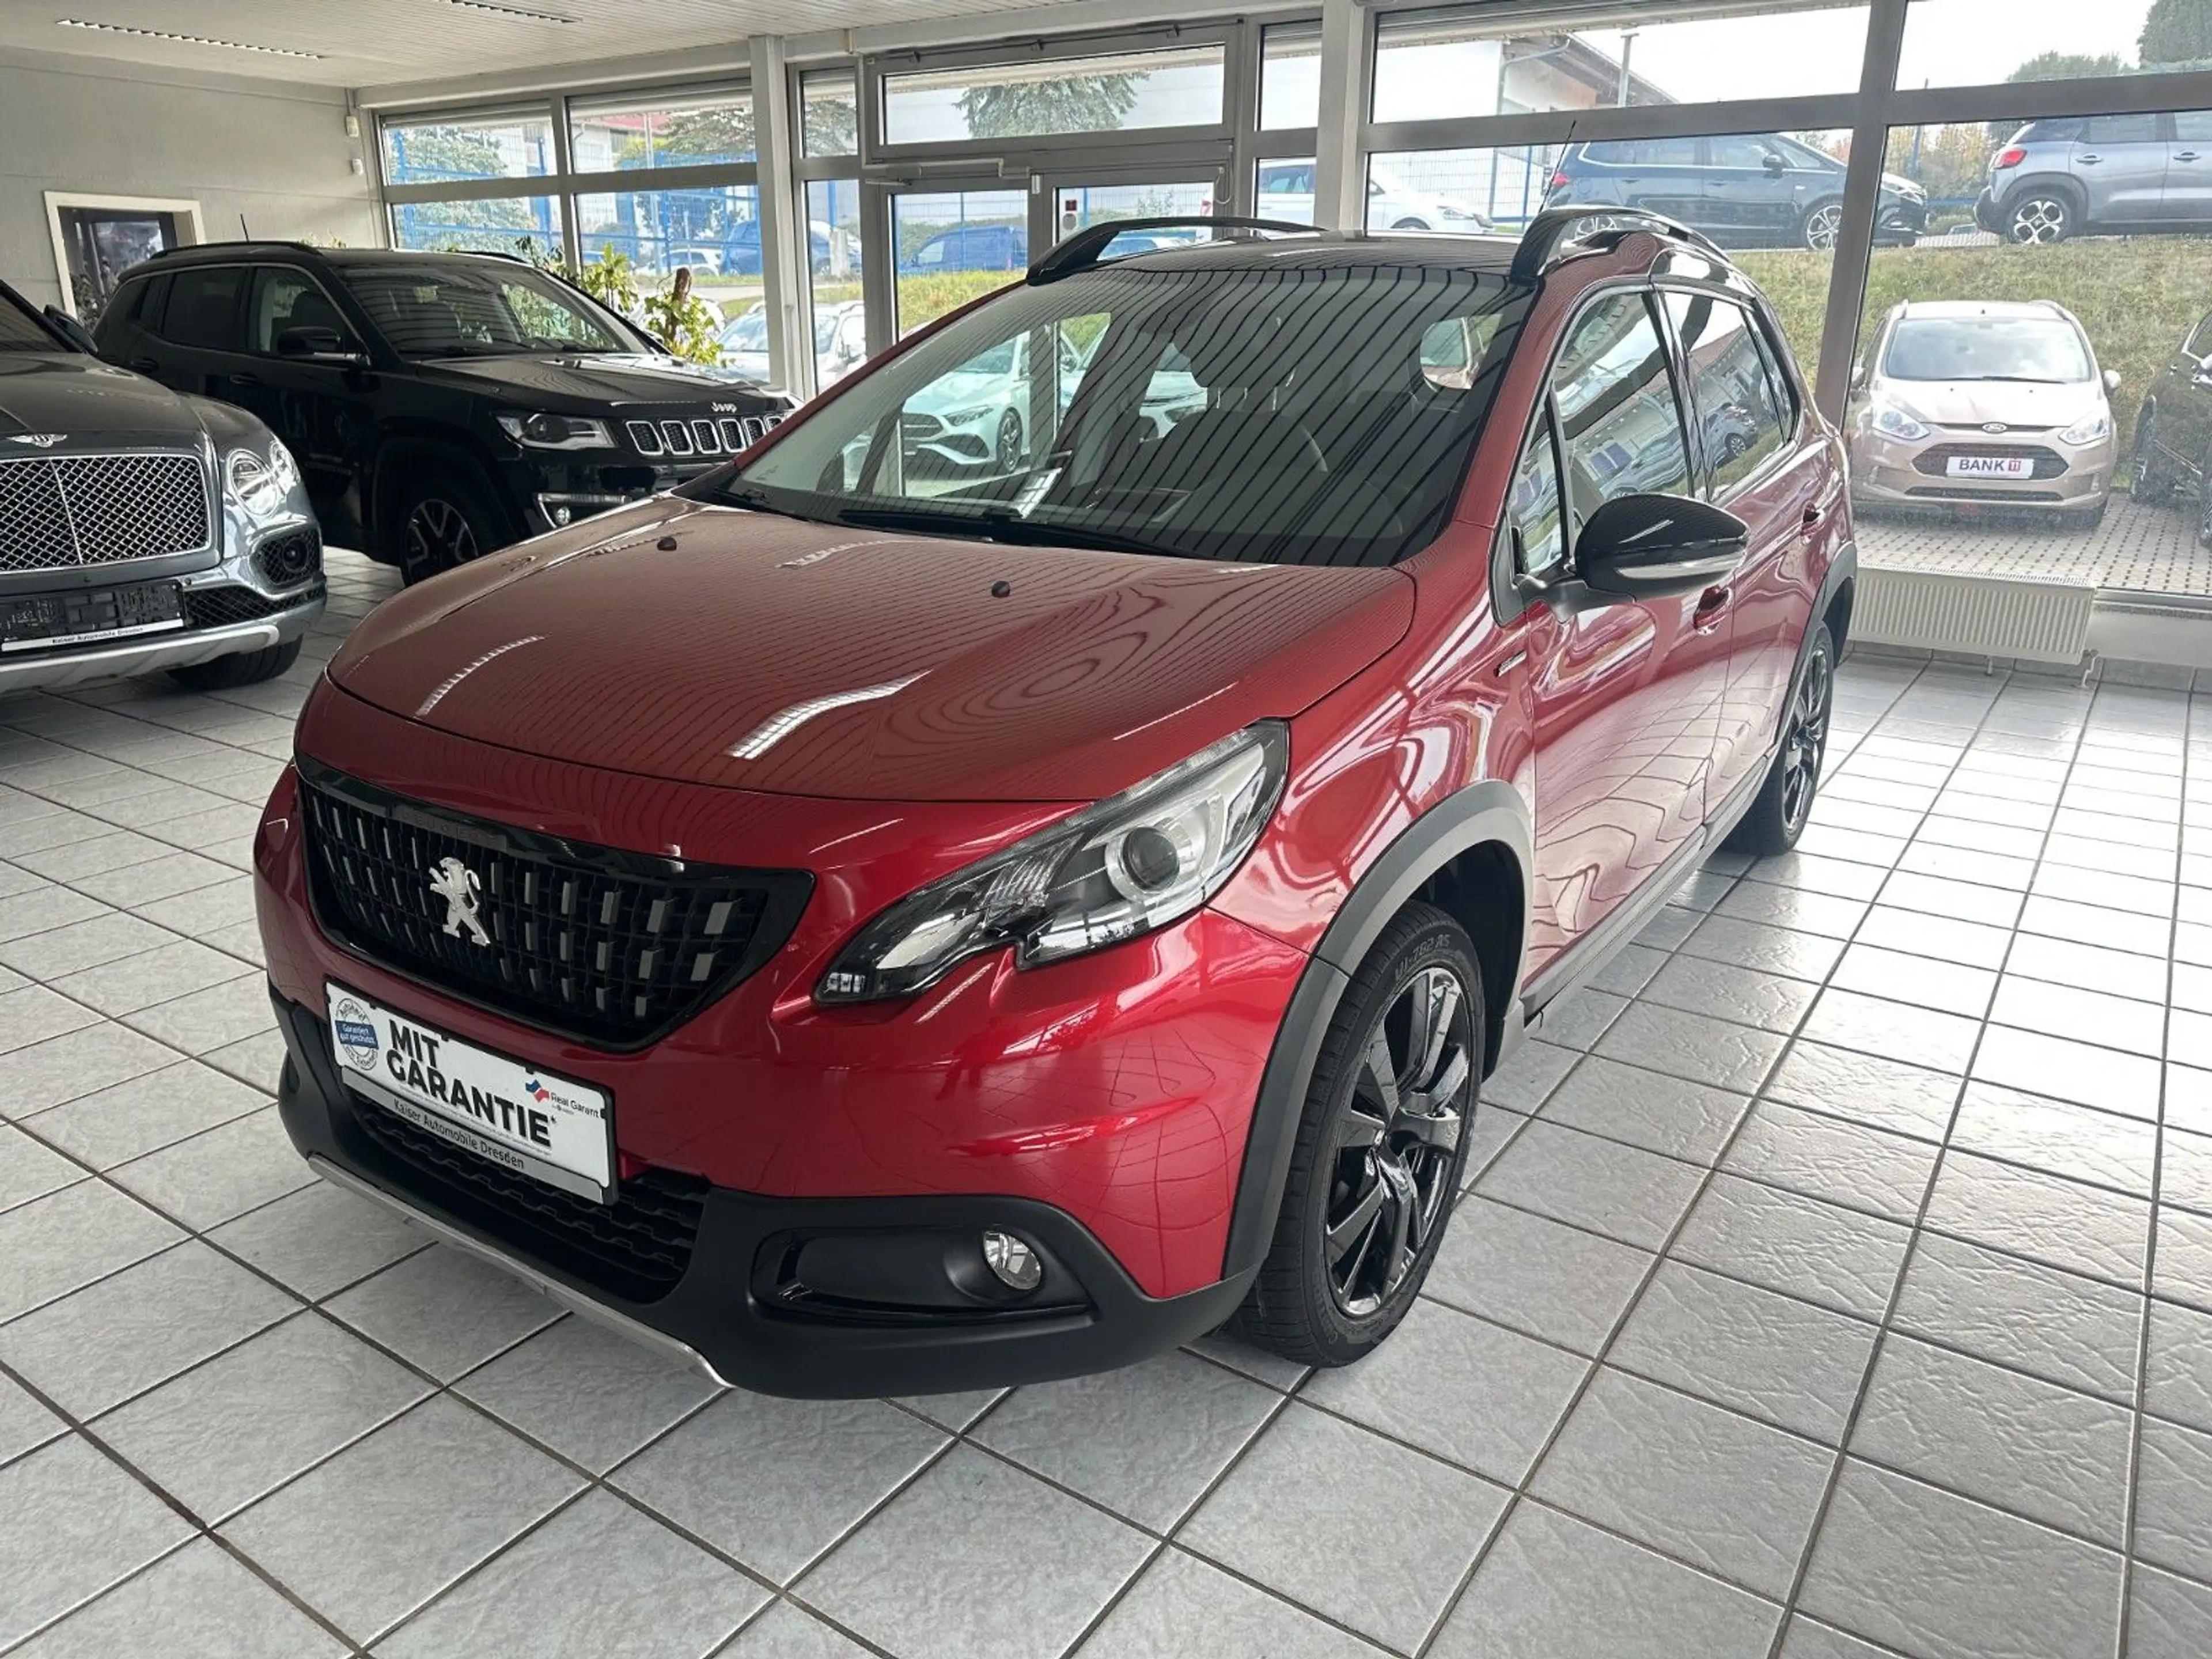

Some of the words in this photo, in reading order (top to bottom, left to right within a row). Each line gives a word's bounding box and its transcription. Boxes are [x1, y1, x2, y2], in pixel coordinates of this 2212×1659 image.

[711, 402, 737, 413] Jeep
[389, 1018, 440, 1068] MIT
[551, 1092, 569, 1107] Real
[570, 1100, 599, 1118] Garant
[394, 1099, 421, 1122] Kaiser
[424, 1114, 478, 1150] Automobile
[480, 1141, 524, 1168] Dresden
